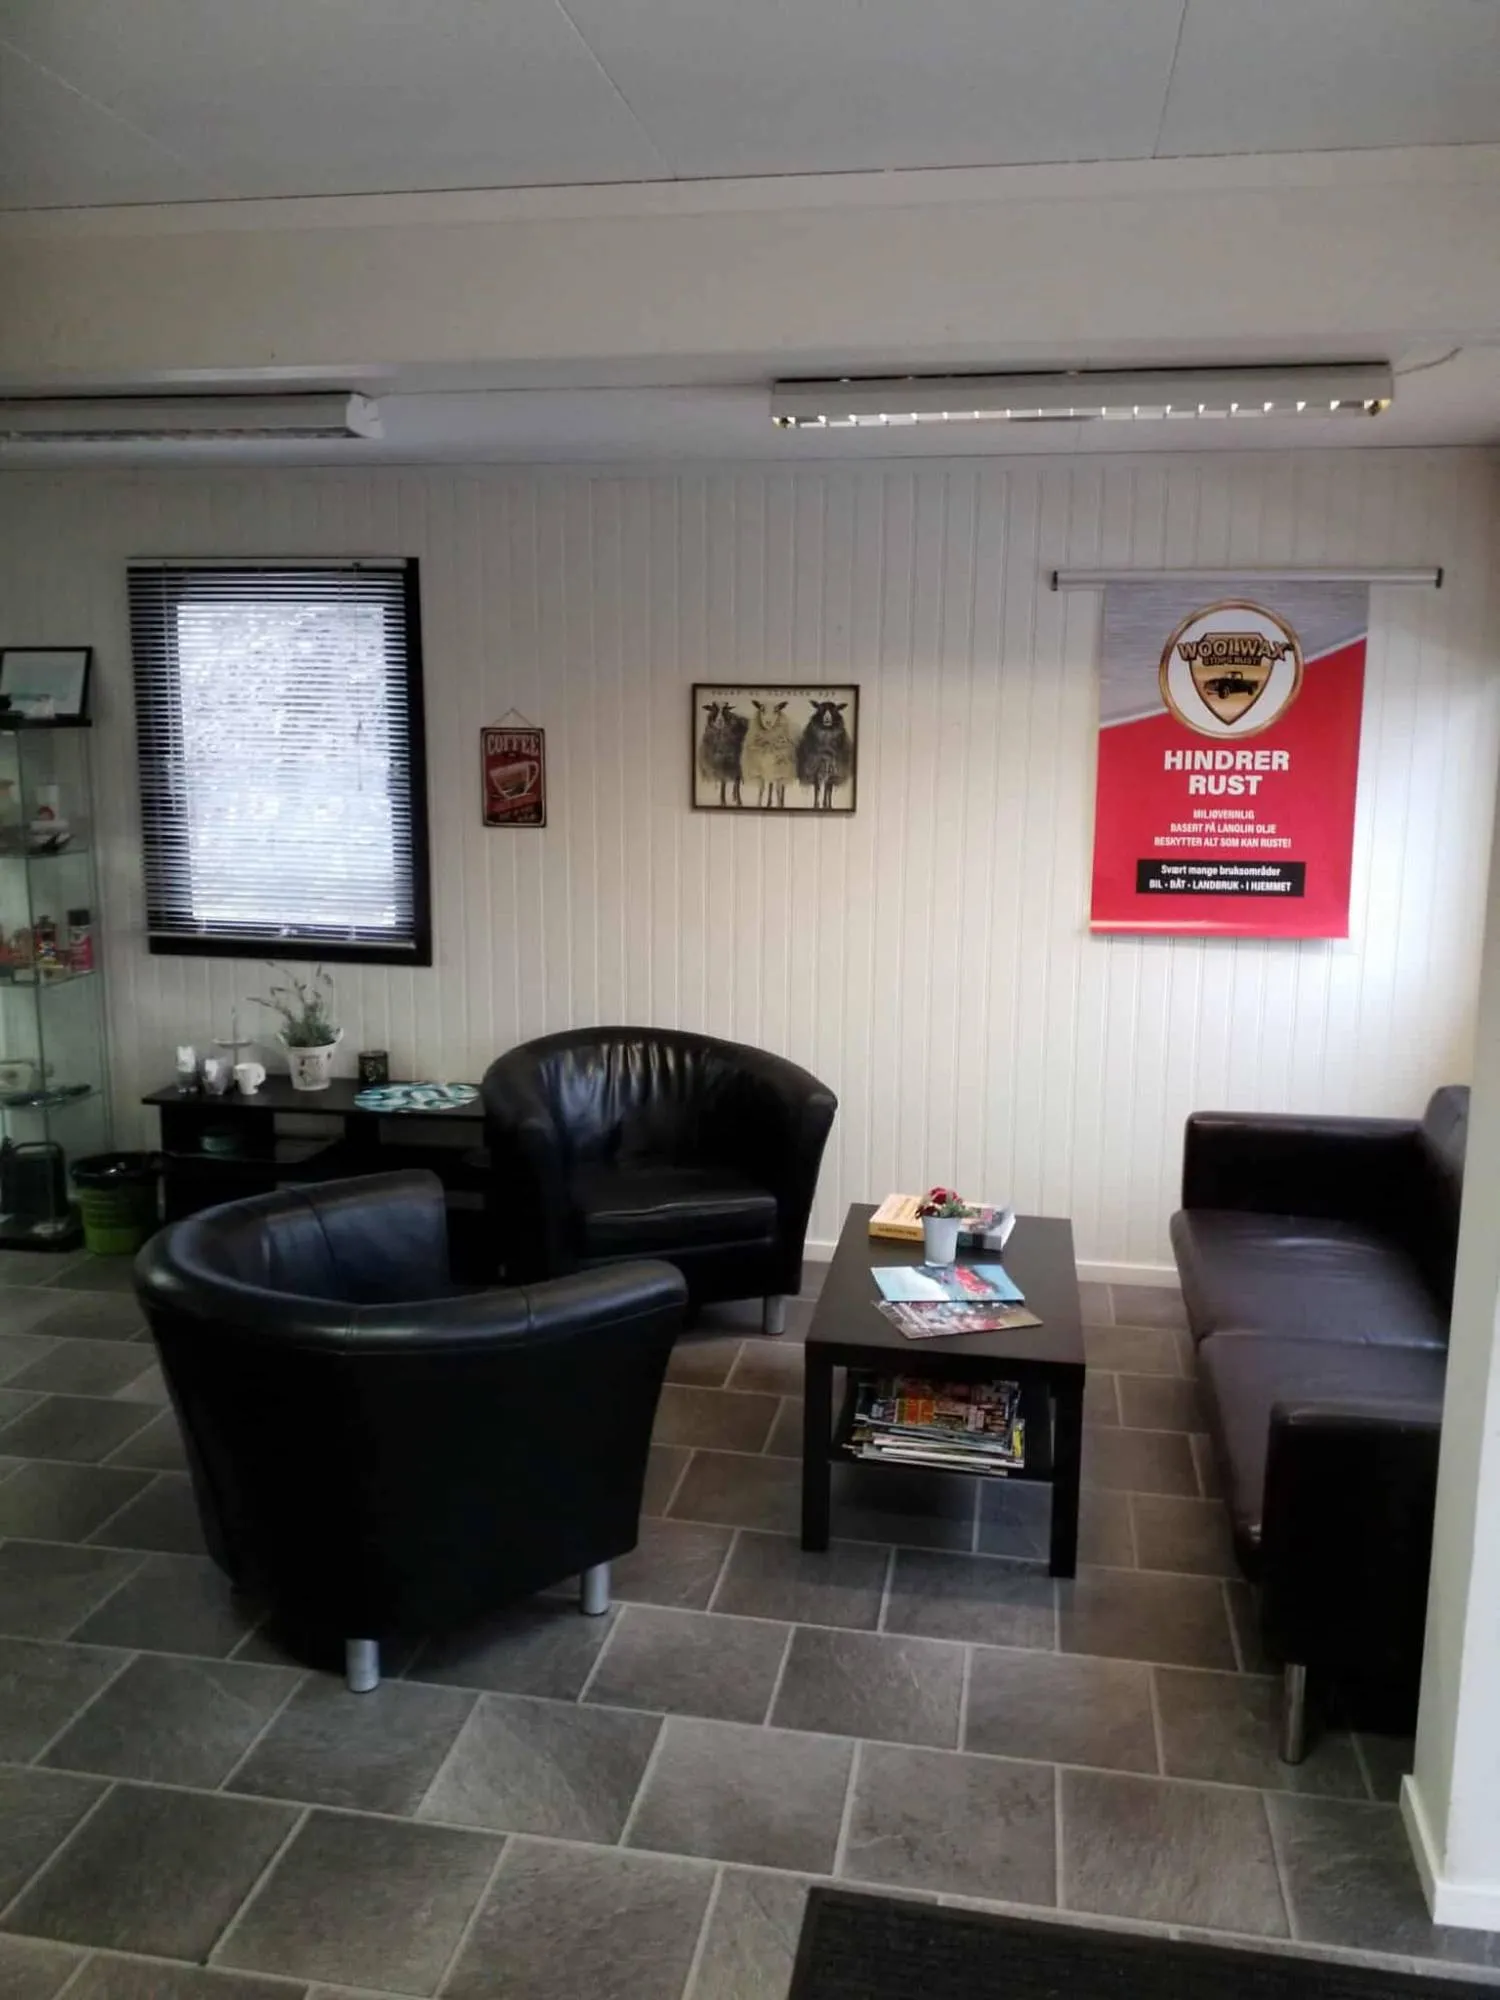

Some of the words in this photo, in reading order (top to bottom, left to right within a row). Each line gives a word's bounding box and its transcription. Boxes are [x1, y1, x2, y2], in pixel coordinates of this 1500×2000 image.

[1177, 638, 1287, 662] WOOLWAX
[487, 734, 540, 757] COFFEE
[1164, 750, 1290, 771] HINDRER
[1189, 775, 1263, 796] RUST
[1170, 823, 1203, 833] BASERT
[1205, 822, 1216, 833] PÅ
[1217, 823, 1254, 834] LANOLIN
[1256, 824, 1277, 834] OLJE
[1154, 836, 1202, 847] BESKYTTER
[1204, 837, 1219, 847] ALT
[1220, 837, 1239, 848] SOM
[1240, 838, 1259, 848] KAN
[1260, 838, 1292, 849] RUSTE!
[1161, 864, 1187, 875] Svært
[1188, 865, 1218, 877] mange
[1219, 865, 1281, 877] bruksområder
[1149, 879, 1165, 889] BIL
[1170, 877, 1186, 890] BÅT
[1192, 880, 1240, 891] LANDBRUK
[1251, 881, 1292, 892] HJEMMET
